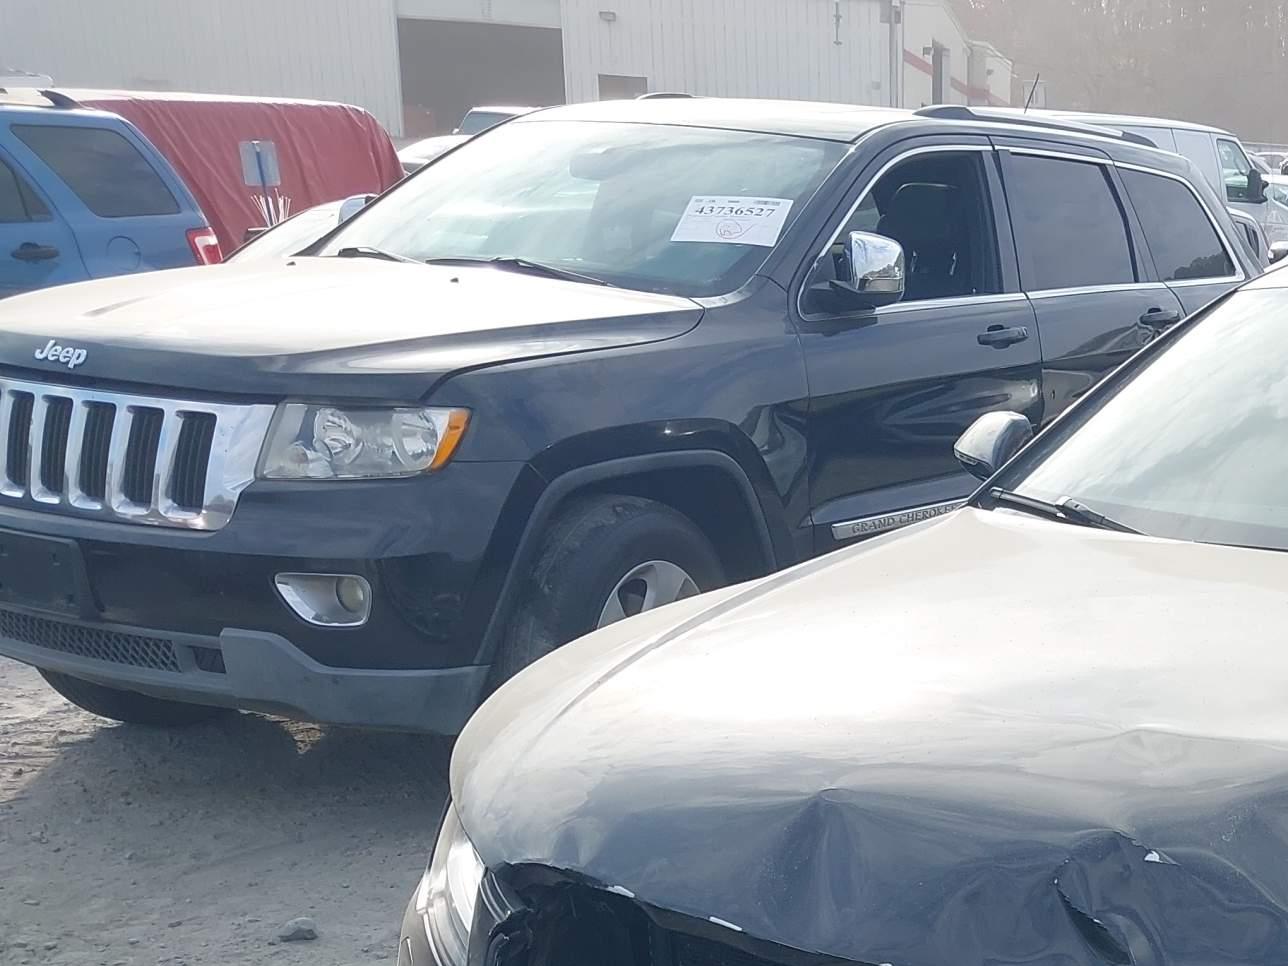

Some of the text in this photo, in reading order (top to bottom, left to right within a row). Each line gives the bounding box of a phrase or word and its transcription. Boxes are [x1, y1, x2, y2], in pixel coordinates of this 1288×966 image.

[695, 205, 776, 217] 43736527
[34, 340, 87, 368] Jeep
[852, 516, 896, 533] GRAND
